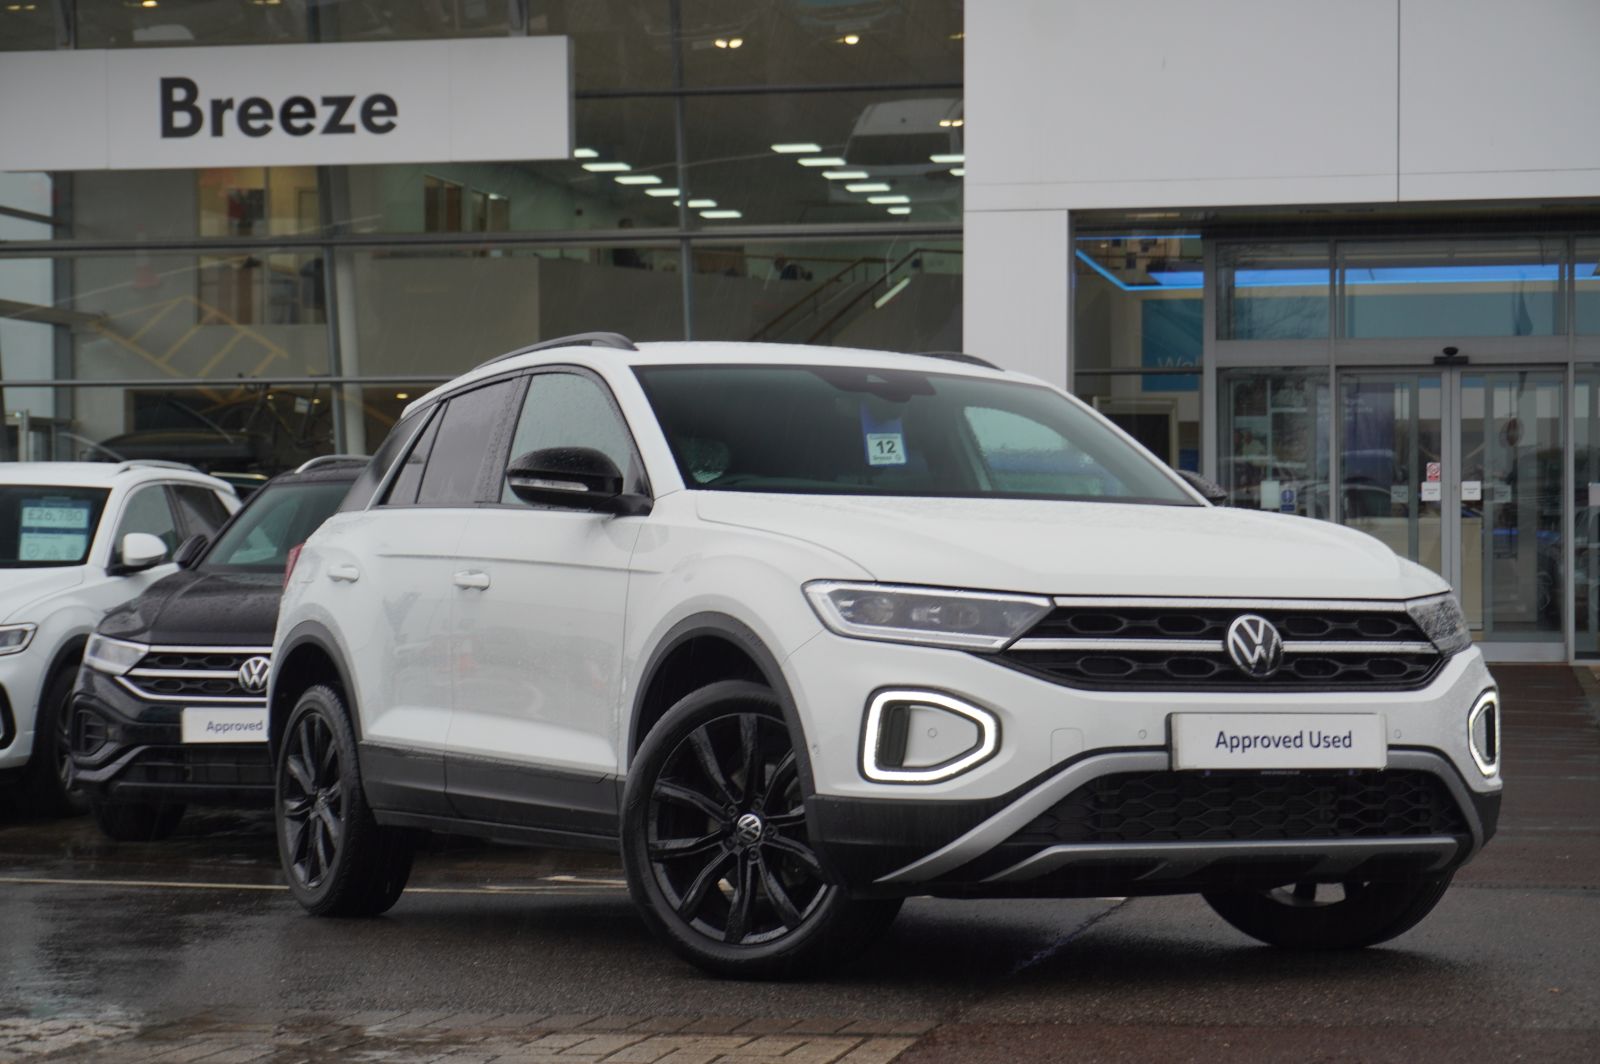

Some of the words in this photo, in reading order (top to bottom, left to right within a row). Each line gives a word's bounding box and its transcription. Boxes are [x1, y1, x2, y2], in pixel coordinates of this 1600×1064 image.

[159, 76, 398, 139] Breeze
[876, 440, 897, 454] 12
[206, 721, 263, 734] Approved
[1215, 730, 1303, 753] Approved
[1309, 730, 1352, 749] Used
